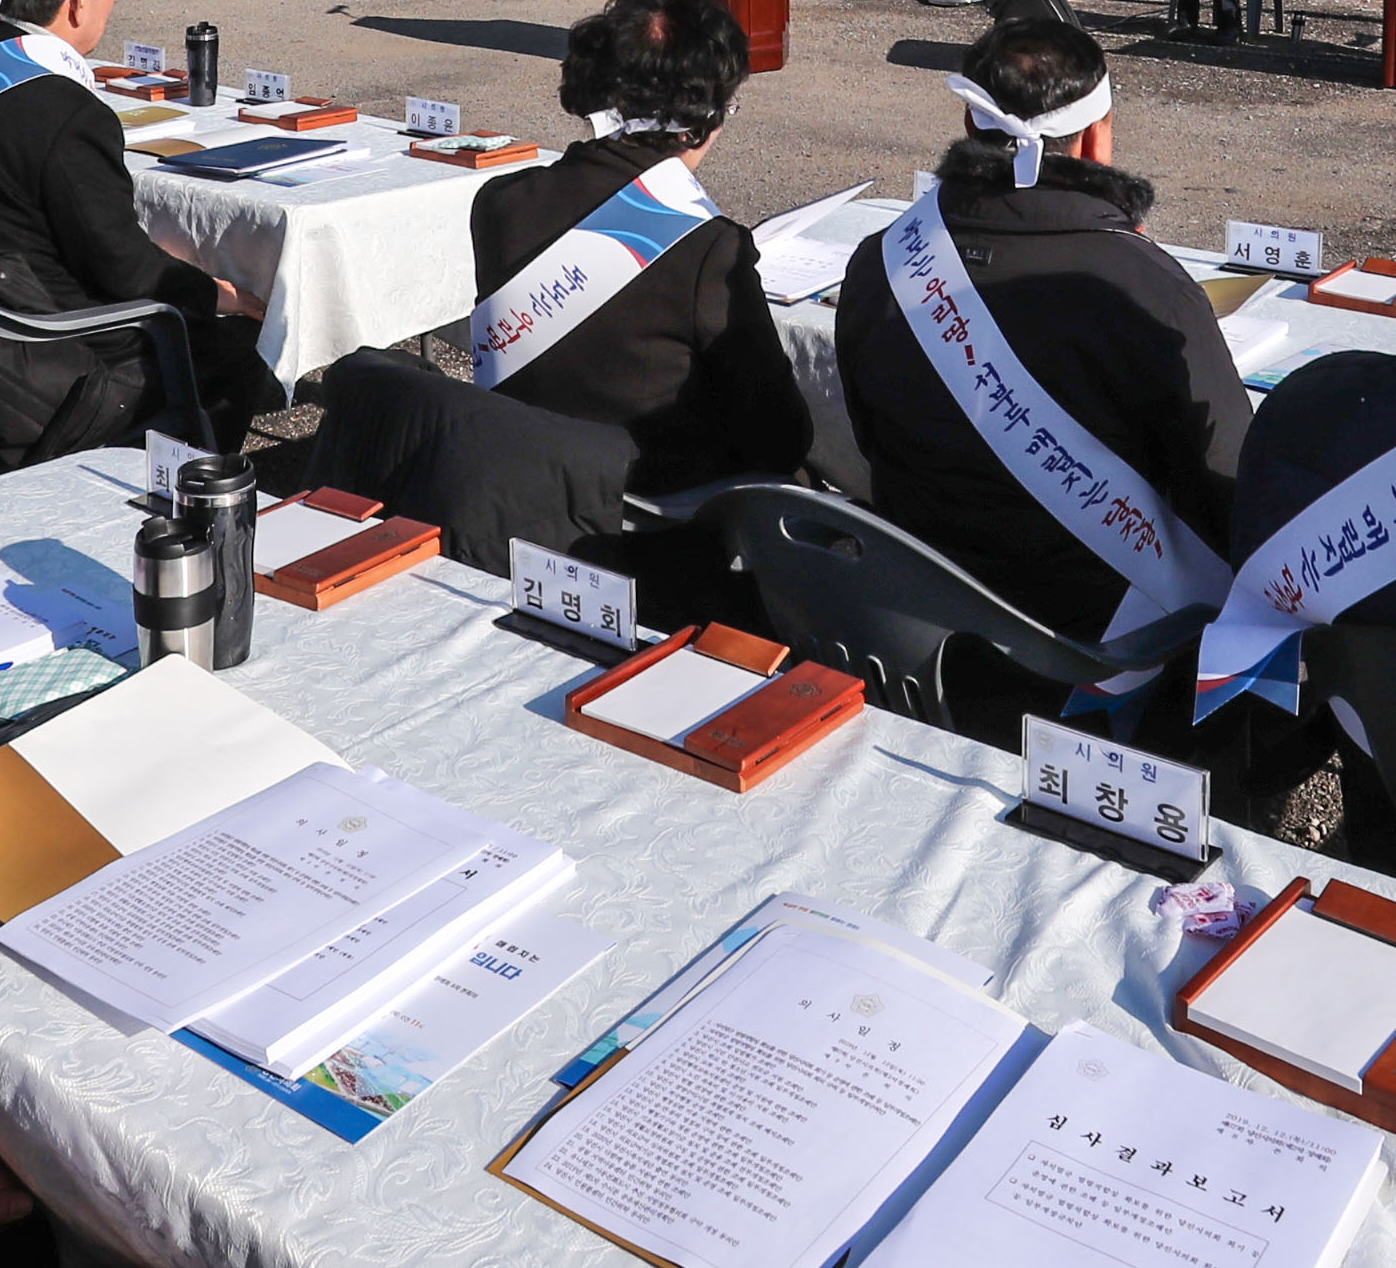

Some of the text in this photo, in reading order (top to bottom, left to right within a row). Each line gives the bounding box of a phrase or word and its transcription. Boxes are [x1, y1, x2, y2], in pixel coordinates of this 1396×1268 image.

[1234, 243, 1312, 270] 서영훈
[1253, 228, 1297, 243] 시의원
[531, 264, 590, 319] 독도는
[897, 215, 933, 280] 독도는
[920, 277, 977, 367] 우리땅!
[973, 361, 1031, 433] 서부두
[1024, 426, 1110, 510] 매립지는
[545, 558, 601, 590] 시의원
[1301, 504, 1390, 594] 매립지는
[523, 577, 622, 638] 김명회
[1075, 742, 1157, 784] 시의원
[1038, 763, 1189, 844] 최창용
[469, 951, 523, 981] 입니다
[1047, 1113, 1286, 1224] 심사결과보고서
